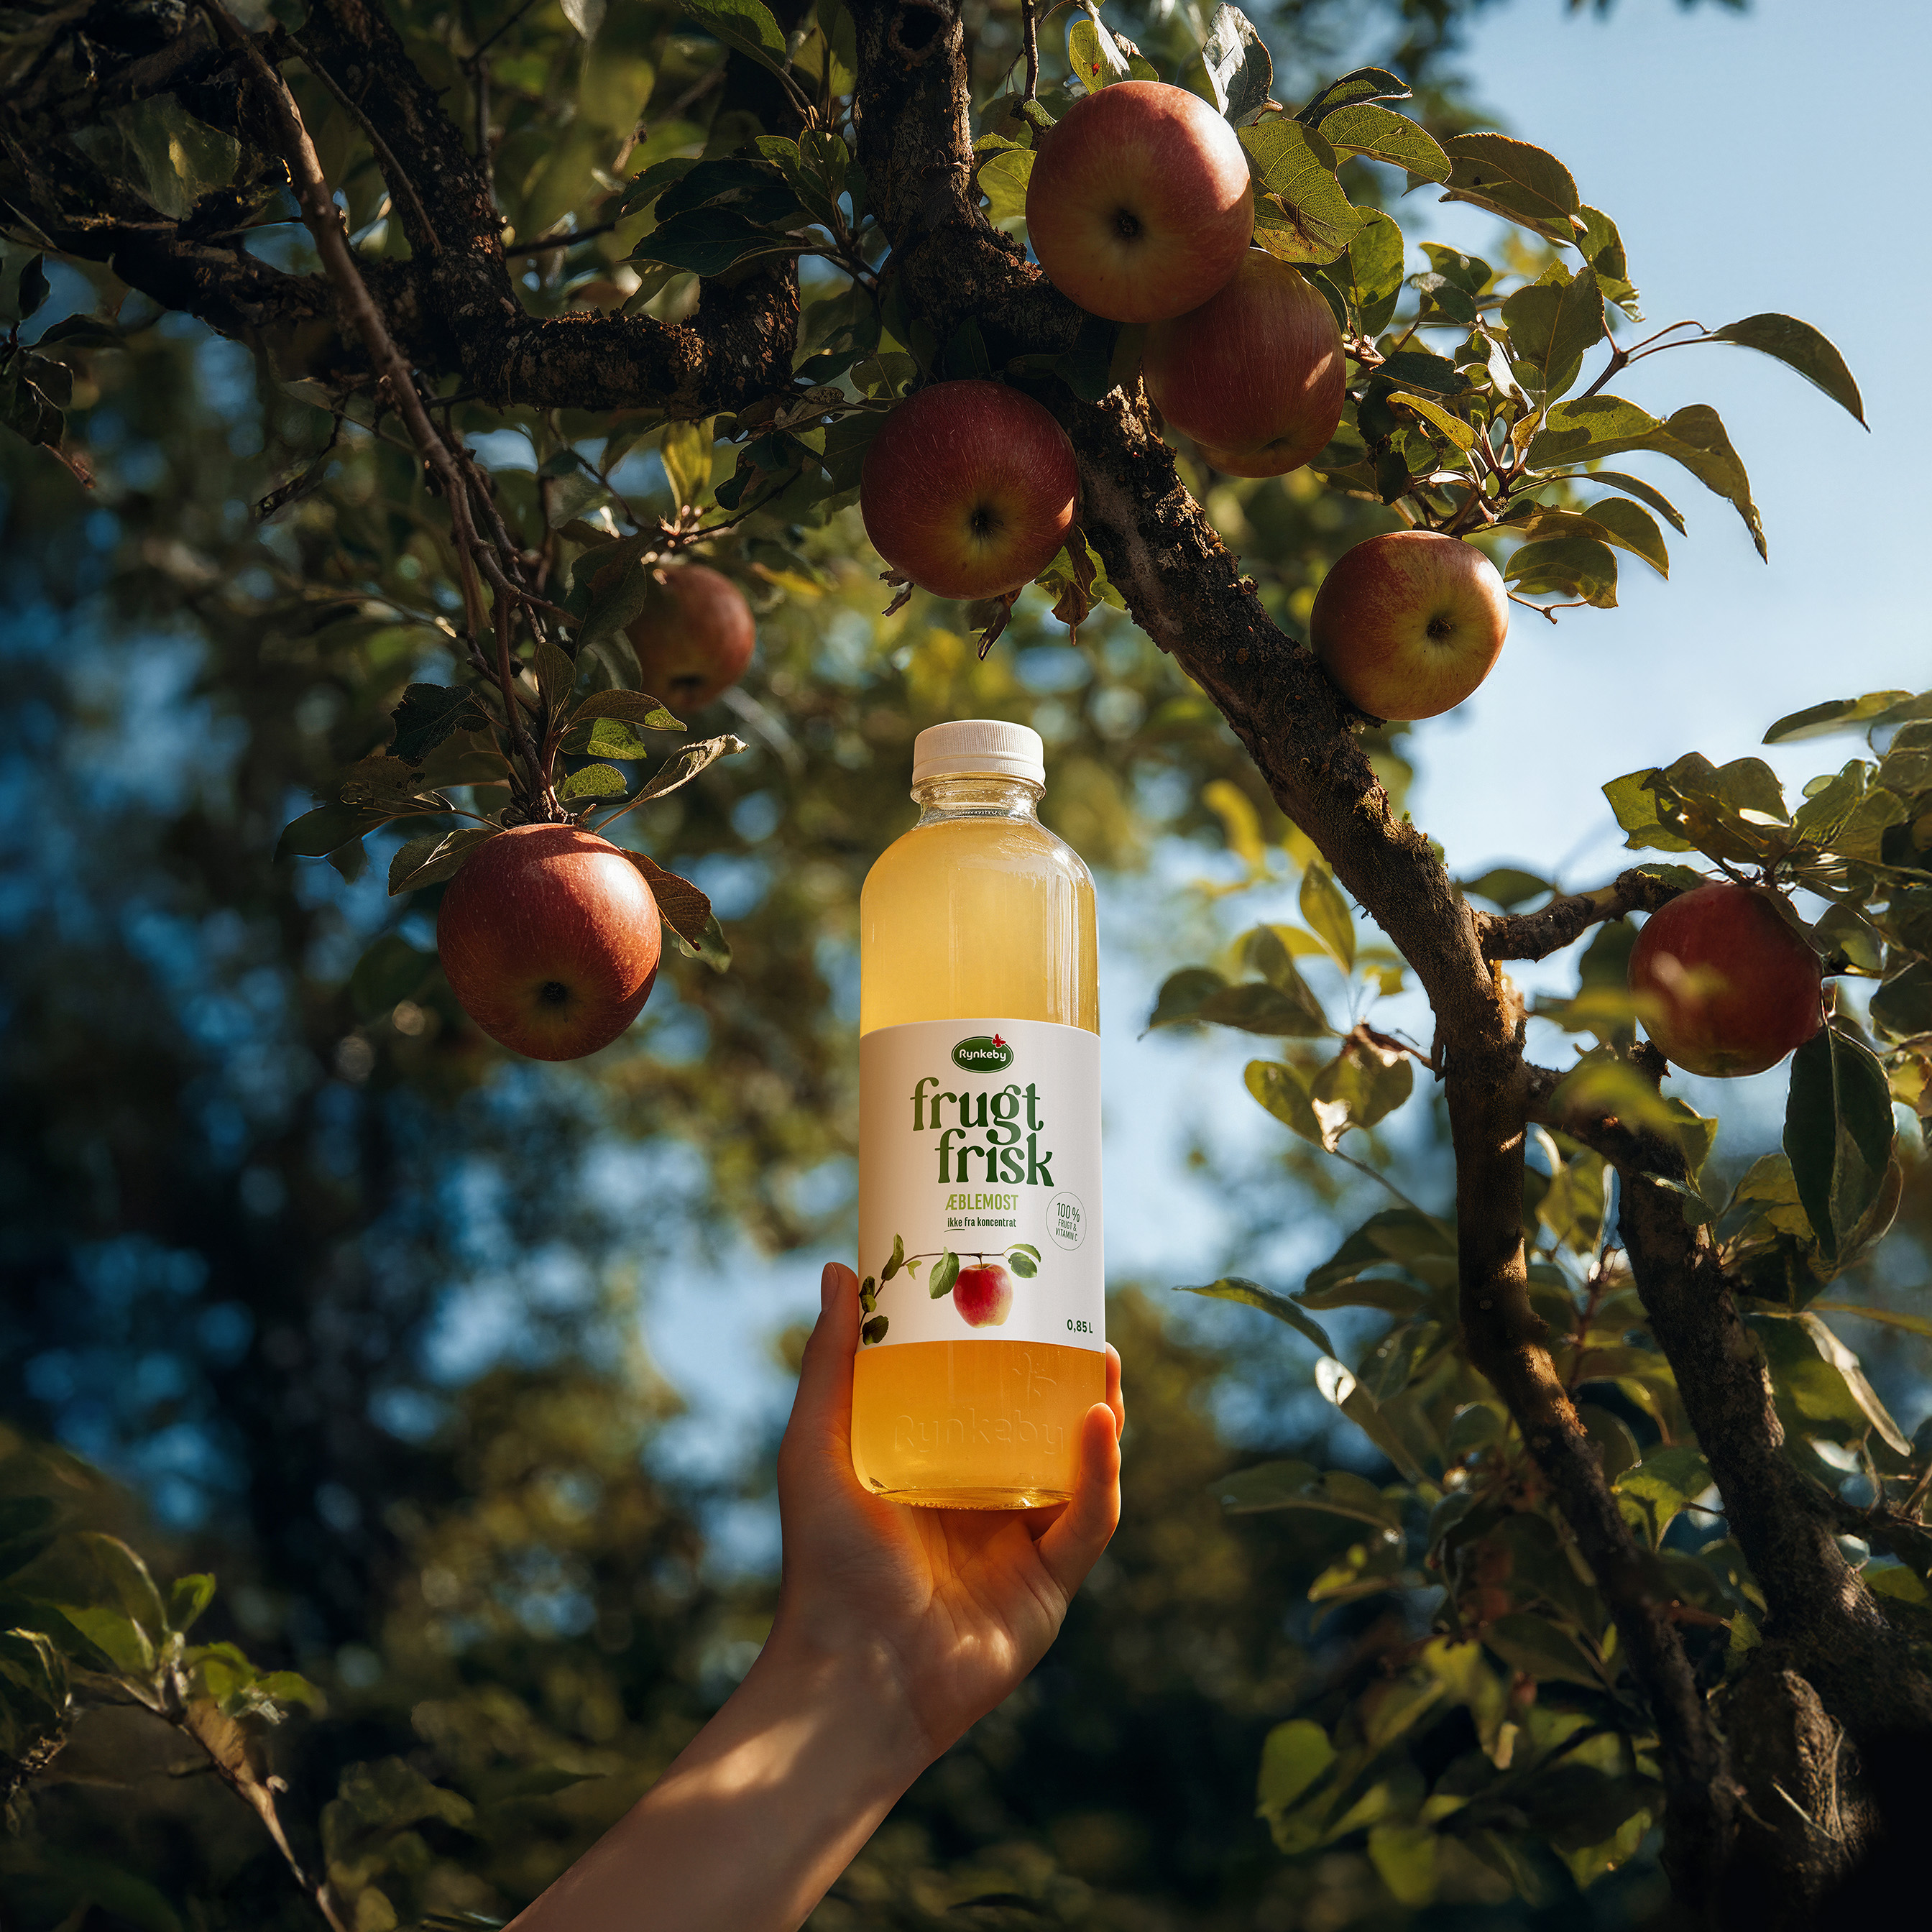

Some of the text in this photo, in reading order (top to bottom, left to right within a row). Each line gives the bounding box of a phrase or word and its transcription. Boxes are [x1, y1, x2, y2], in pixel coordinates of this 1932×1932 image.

[959, 1049, 1007, 1062] Rynkeby
[910, 1077, 1044, 1146] frugt
[934, 1128, 1054, 1187] frisk
[945, 1194, 1018, 1210] ÆBLEMOST
[1057, 1202, 1080, 1222] 100 %
[947, 1217, 1017, 1228] ikke fra koncentrat
[1058, 1218, 1072, 1230] FRUGT
[1056, 1228, 1074, 1240] VITAMIN
[1067, 1319, 1093, 1333] 0,85 L
